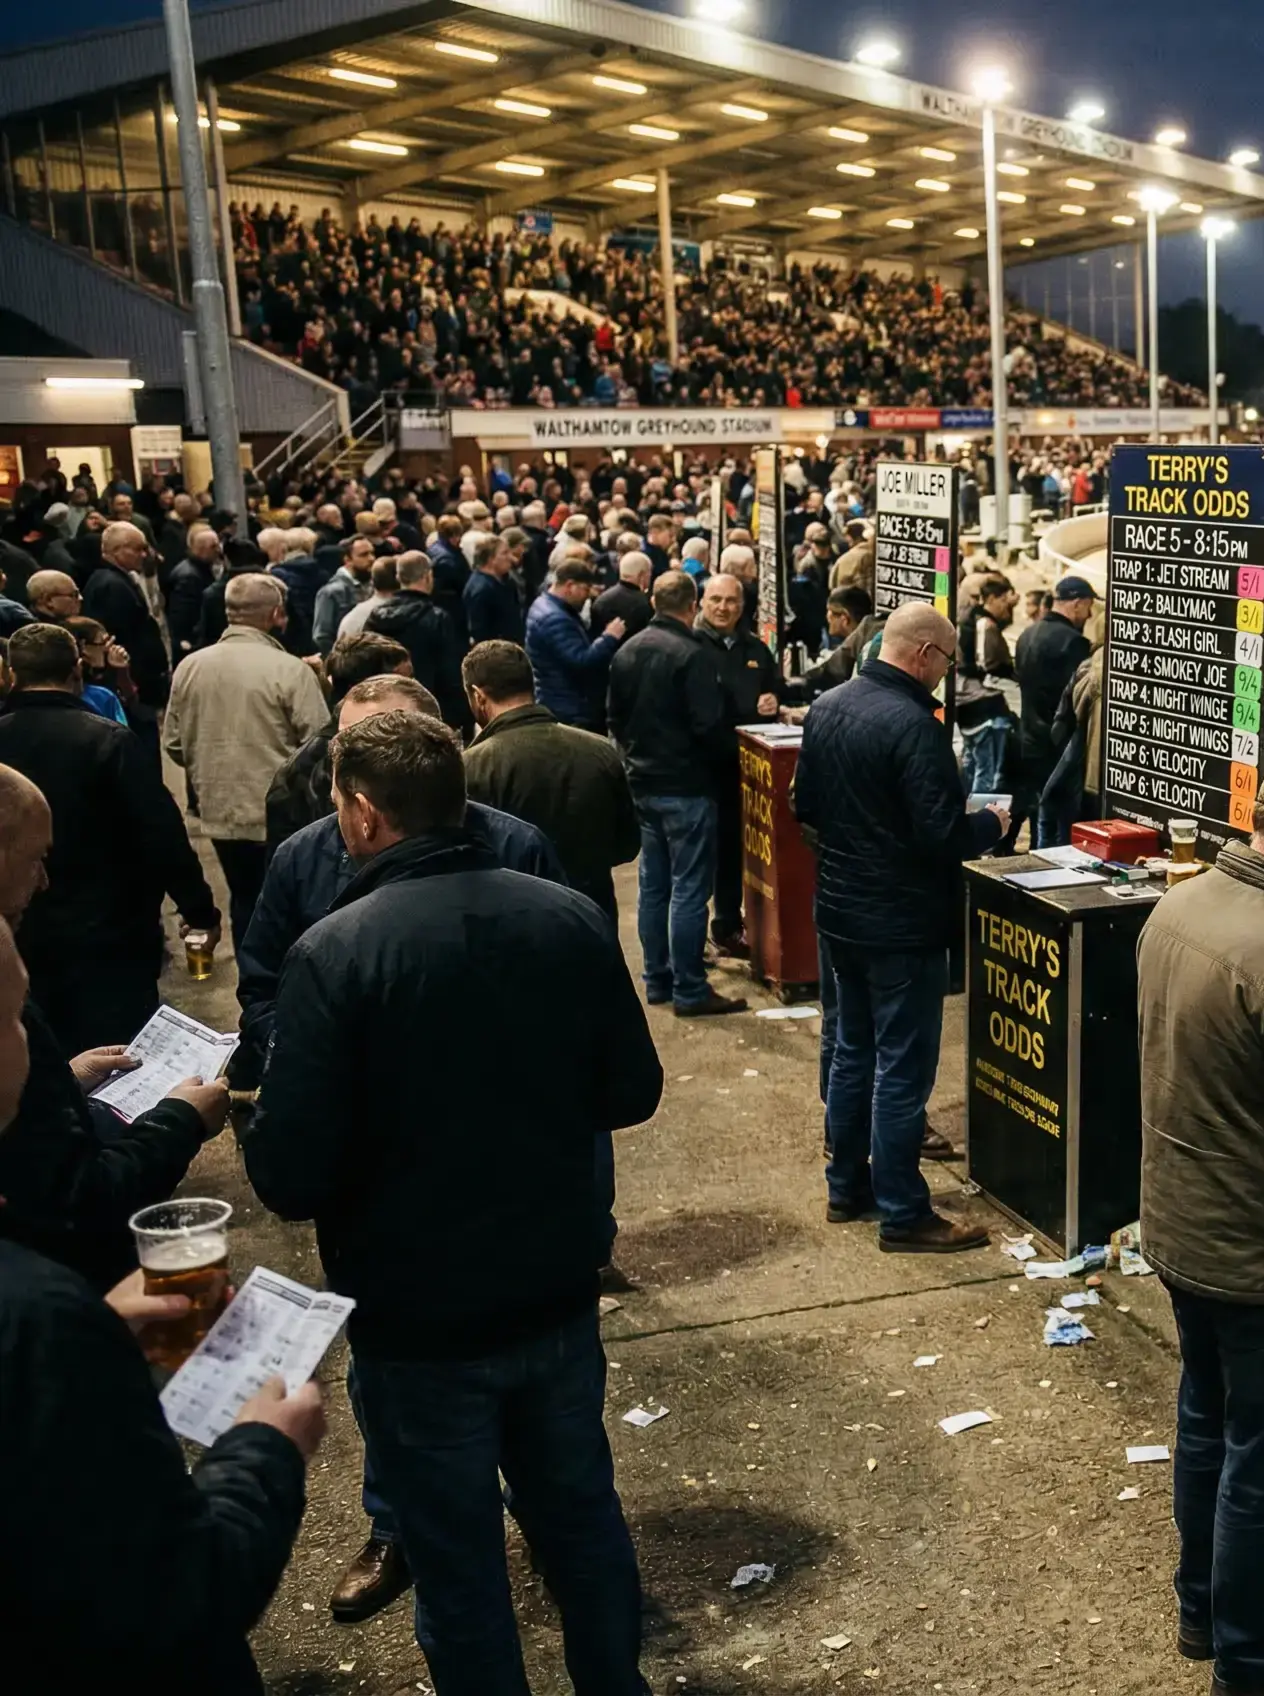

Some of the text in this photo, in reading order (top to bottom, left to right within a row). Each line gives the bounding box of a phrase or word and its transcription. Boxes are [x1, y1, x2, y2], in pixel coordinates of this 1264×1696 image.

[637, 418, 716, 435] GREYHOUND
[722, 418, 772, 433] STADIUM
[881, 470, 946, 498] JOE MILLER
[1147, 455, 1228, 484] TERRY'S
[1124, 486, 1250, 518] TRACK ODDS
[1125, 524, 1166, 551] RACE
[1170, 528, 1180, 553] 5
[1194, 529, 1229, 561] 8:15
[1231, 540, 1248, 559] PM
[1114, 559, 1229, 590] TRAP 1: JET STREAM
[1241, 572, 1260, 595] 5/1
[1113, 589, 1216, 621] TRAP 2: BALLYMAC
[1241, 605, 1258, 628] 3/1
[1112, 619, 1221, 655] TRAP 3: FLASH GIRL
[1240, 637, 1259, 661] 4/1
[1112, 649, 1227, 688] TRAP 4: SMOKEY JOE
[1238, 671, 1257, 694] 9/4
[1111, 679, 1138, 701] TRAP
[1140, 685, 1150, 705] 4:
[1153, 686, 1188, 711] NIGHT
[1110, 708, 1229, 753] TRAP 5: NIGHT WINGS
[1236, 703, 1256, 726] 9/4
[1109, 737, 1206, 780] TRAP 6: VELOCITY
[1235, 735, 1254, 756] 7/2
[1109, 767, 1206, 812] TRAP 6: VELOCITY
[1235, 773, 1251, 793] 6/1
[977, 908, 1060, 978] TERRY'S
[984, 959, 1050, 1025] TRACK
[989, 1010, 1044, 1070] ODDS
